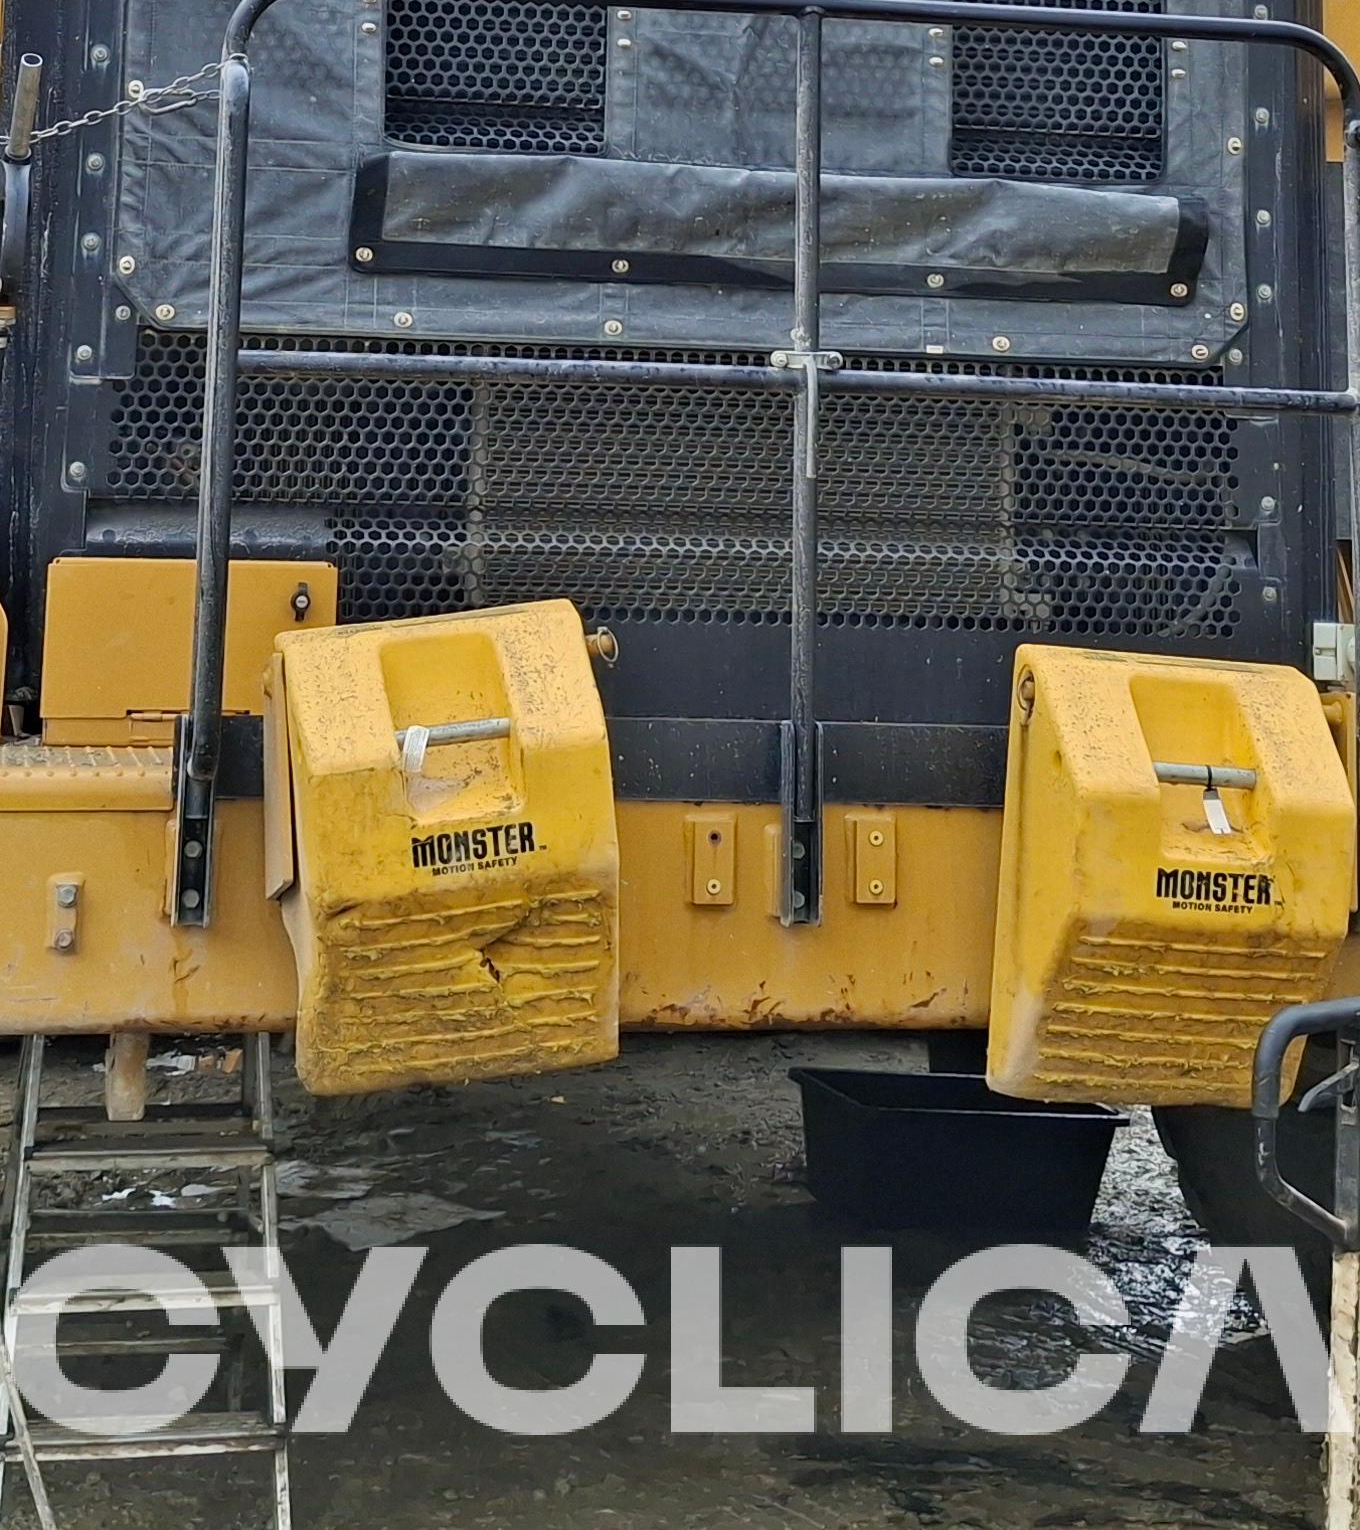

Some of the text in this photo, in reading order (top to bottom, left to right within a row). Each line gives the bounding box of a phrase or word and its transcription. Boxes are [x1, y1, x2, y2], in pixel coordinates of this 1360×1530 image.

[411, 821, 535, 868] MONSTER
[432, 856, 518, 877] MOTION SAFETY
[1156, 867, 1274, 906] MONSTER
[1172, 900, 1253, 914] MOTION SAFETY
